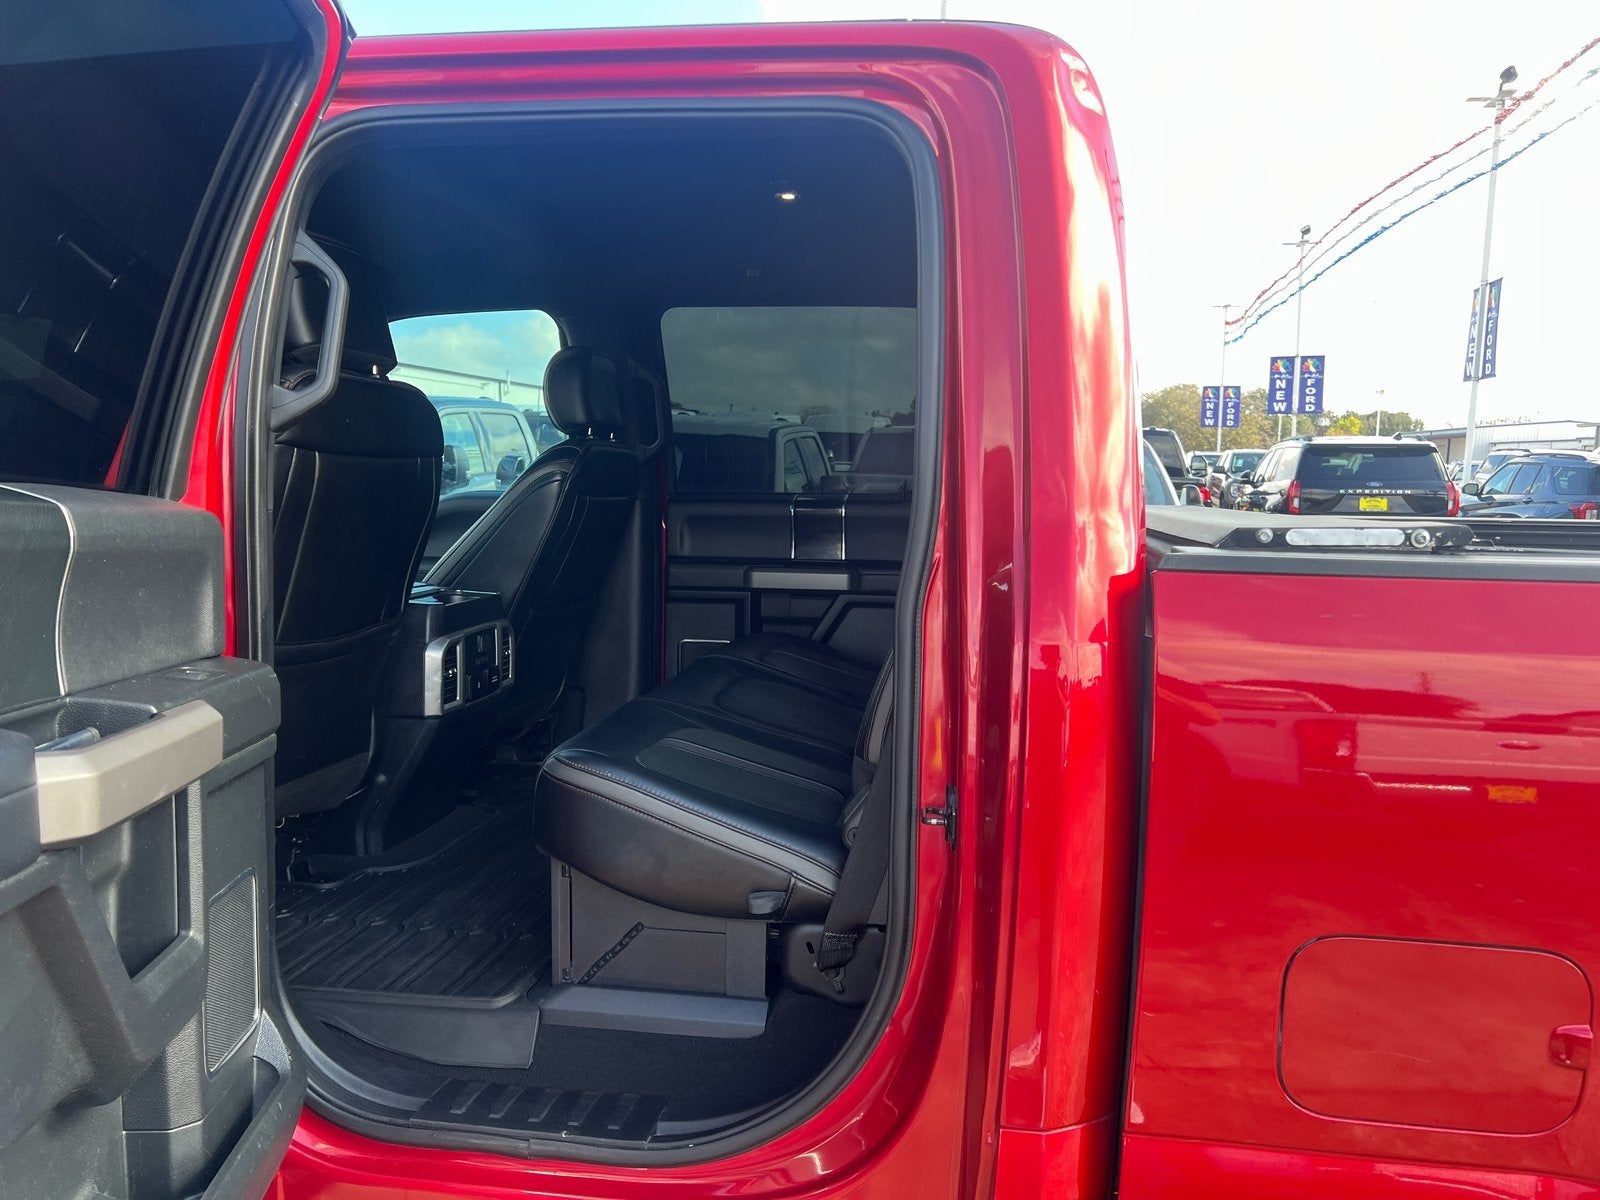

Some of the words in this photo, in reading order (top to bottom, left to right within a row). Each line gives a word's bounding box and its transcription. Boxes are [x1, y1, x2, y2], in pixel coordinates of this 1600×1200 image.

[1485, 320, 1494, 375] FORD
[1273, 379, 1287, 412] NEW
[1305, 378, 1316, 412] FORD
[1204, 402, 1214, 426] NEW
[1226, 402, 1235, 426] FORD
